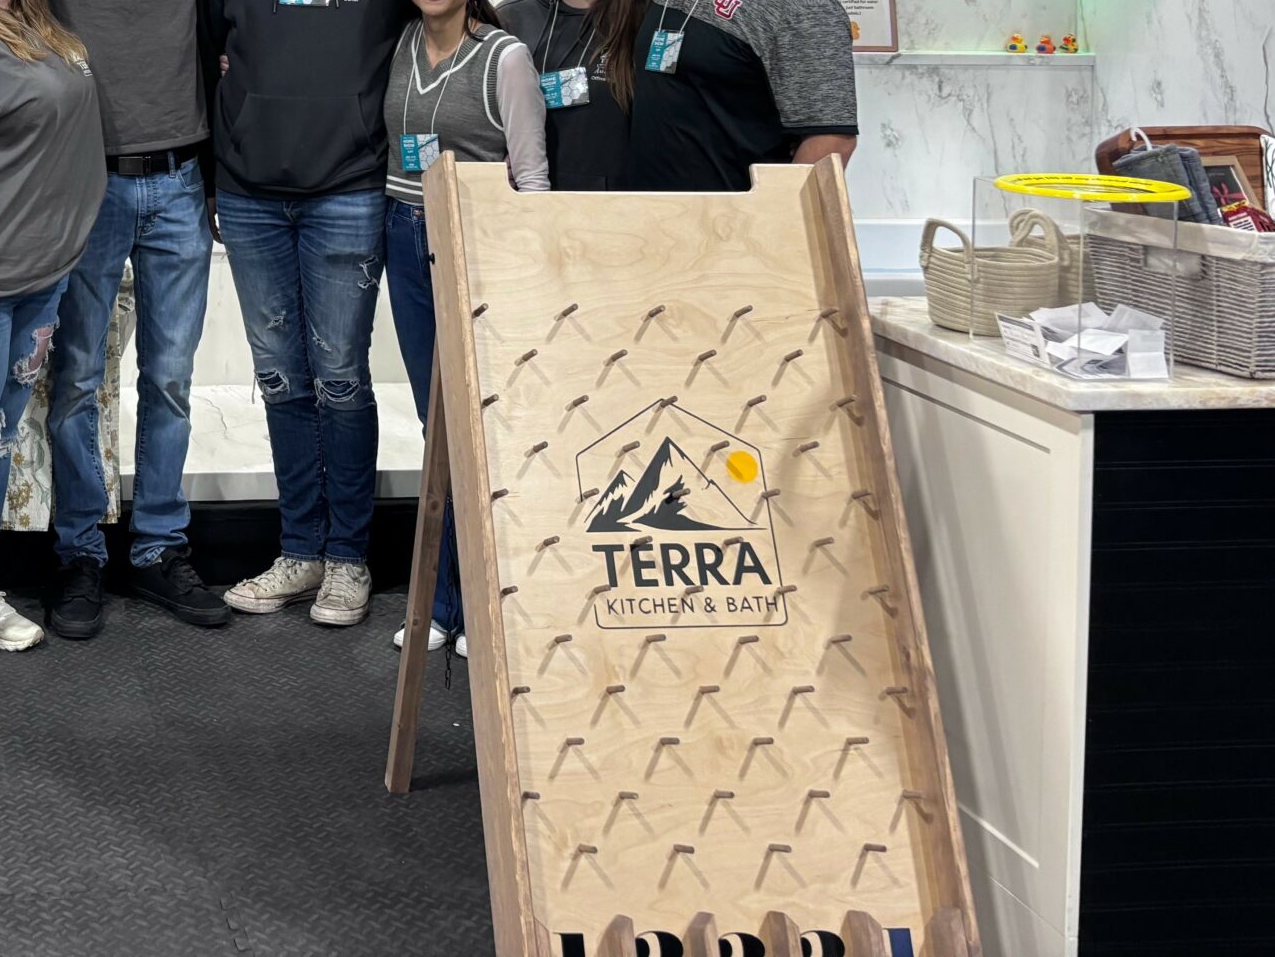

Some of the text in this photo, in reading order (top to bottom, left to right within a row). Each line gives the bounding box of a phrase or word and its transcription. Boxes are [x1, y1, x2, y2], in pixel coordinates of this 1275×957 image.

[591, 541, 773, 588] TERRA
[606, 595, 779, 615] KITCHEN & BATH
